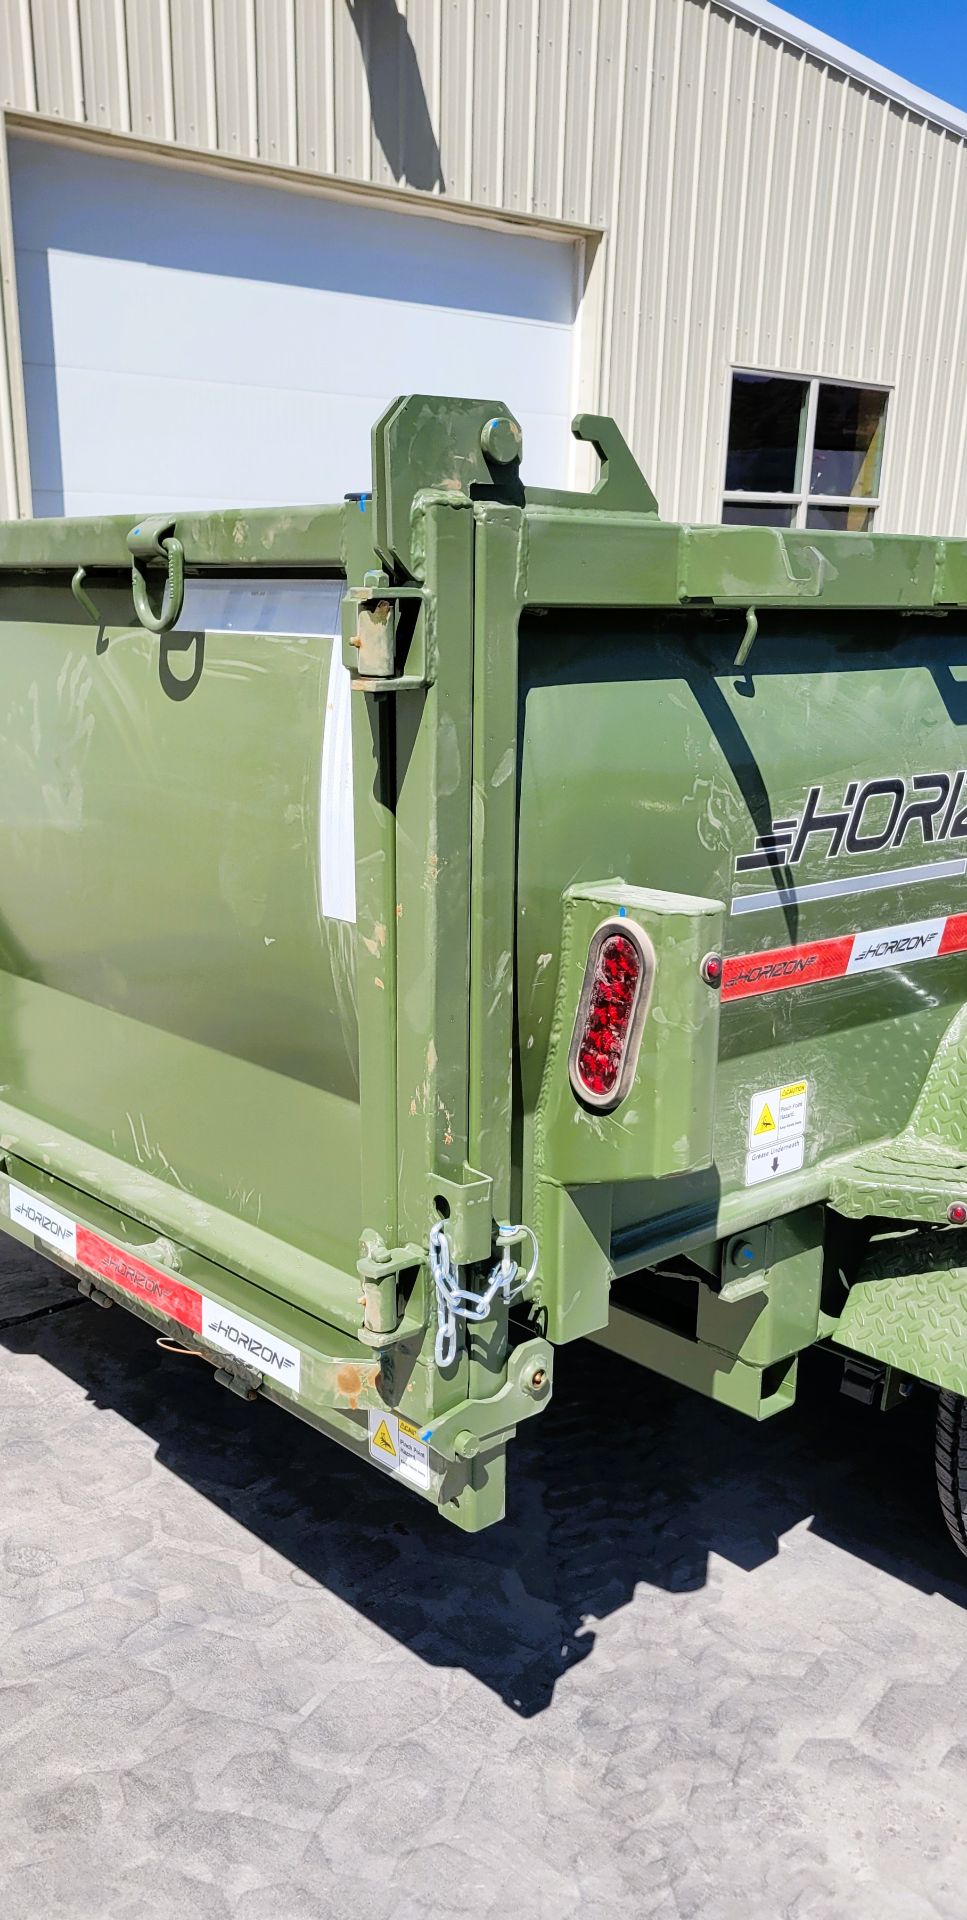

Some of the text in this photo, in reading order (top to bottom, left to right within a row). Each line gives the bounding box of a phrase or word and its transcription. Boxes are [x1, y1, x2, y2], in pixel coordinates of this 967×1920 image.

[867, 935, 932, 958] HORIZON
[735, 957, 809, 984] HORIZON
[751, 1141, 800, 1161] Grease Underneath
[20, 1202, 67, 1240] HORIZON
[107, 1256, 164, 1298] HORIZON
[218, 1320, 285, 1370] HORIZON
